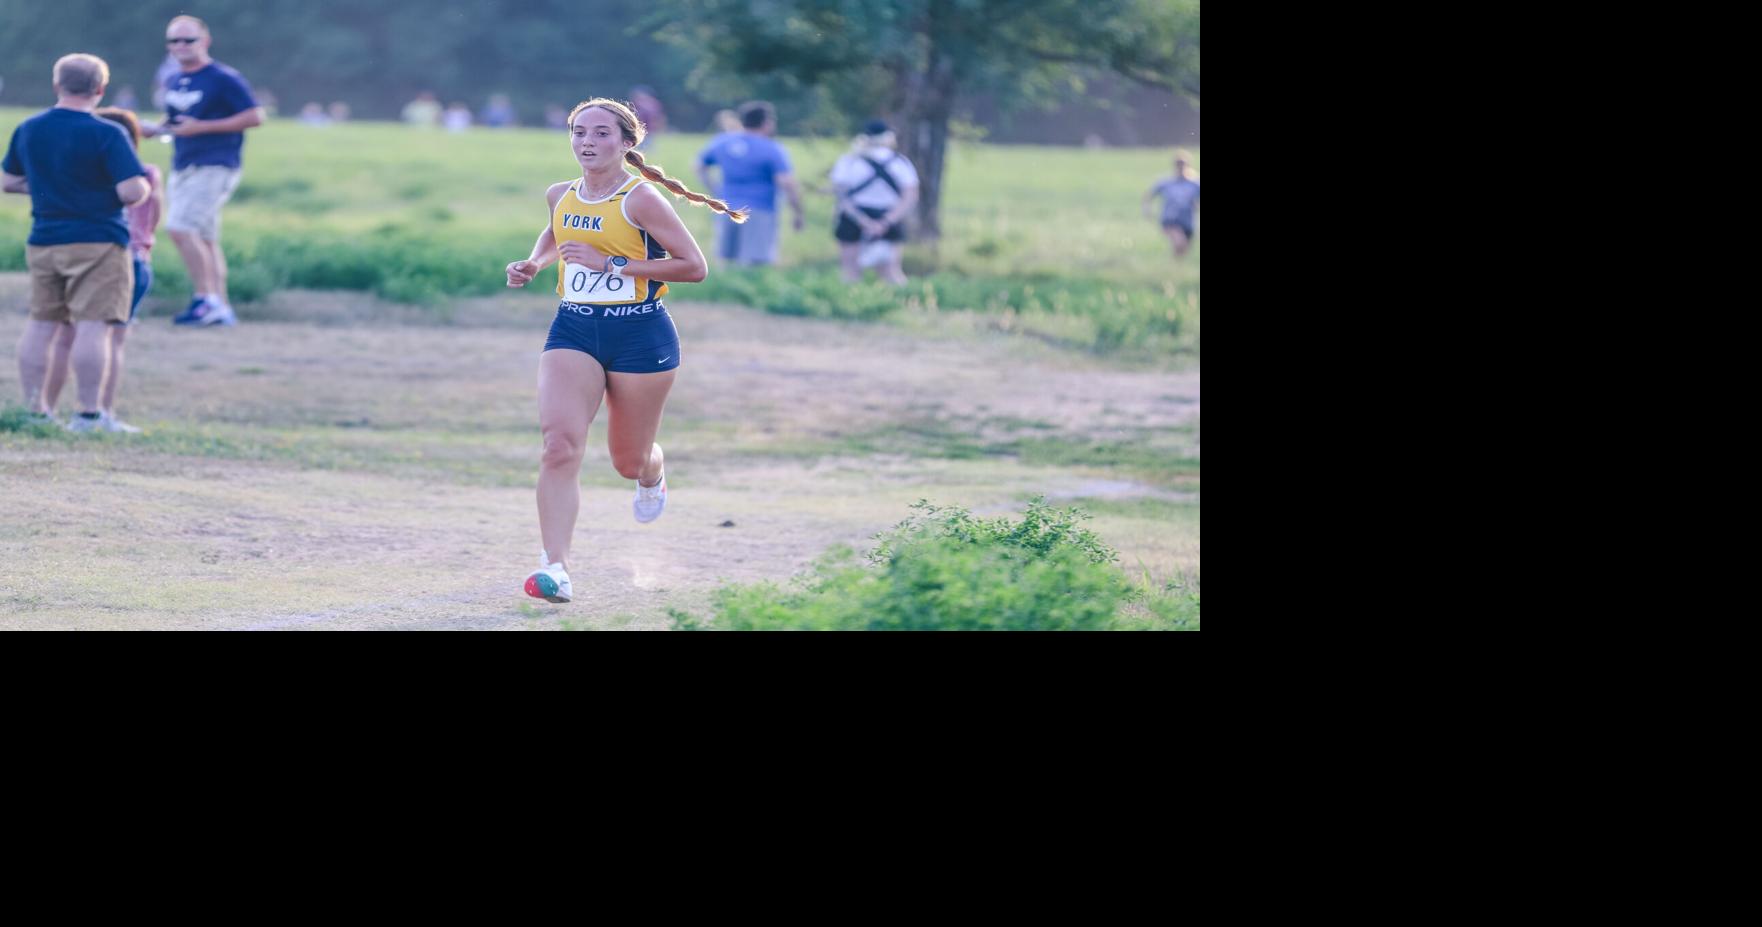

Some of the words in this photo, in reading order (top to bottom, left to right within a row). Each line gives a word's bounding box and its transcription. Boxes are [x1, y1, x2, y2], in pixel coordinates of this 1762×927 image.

[563, 213, 603, 232] YORK
[571, 271, 624, 293] 076
[561, 300, 594, 315] PRO
[603, 303, 654, 317] NIKE
